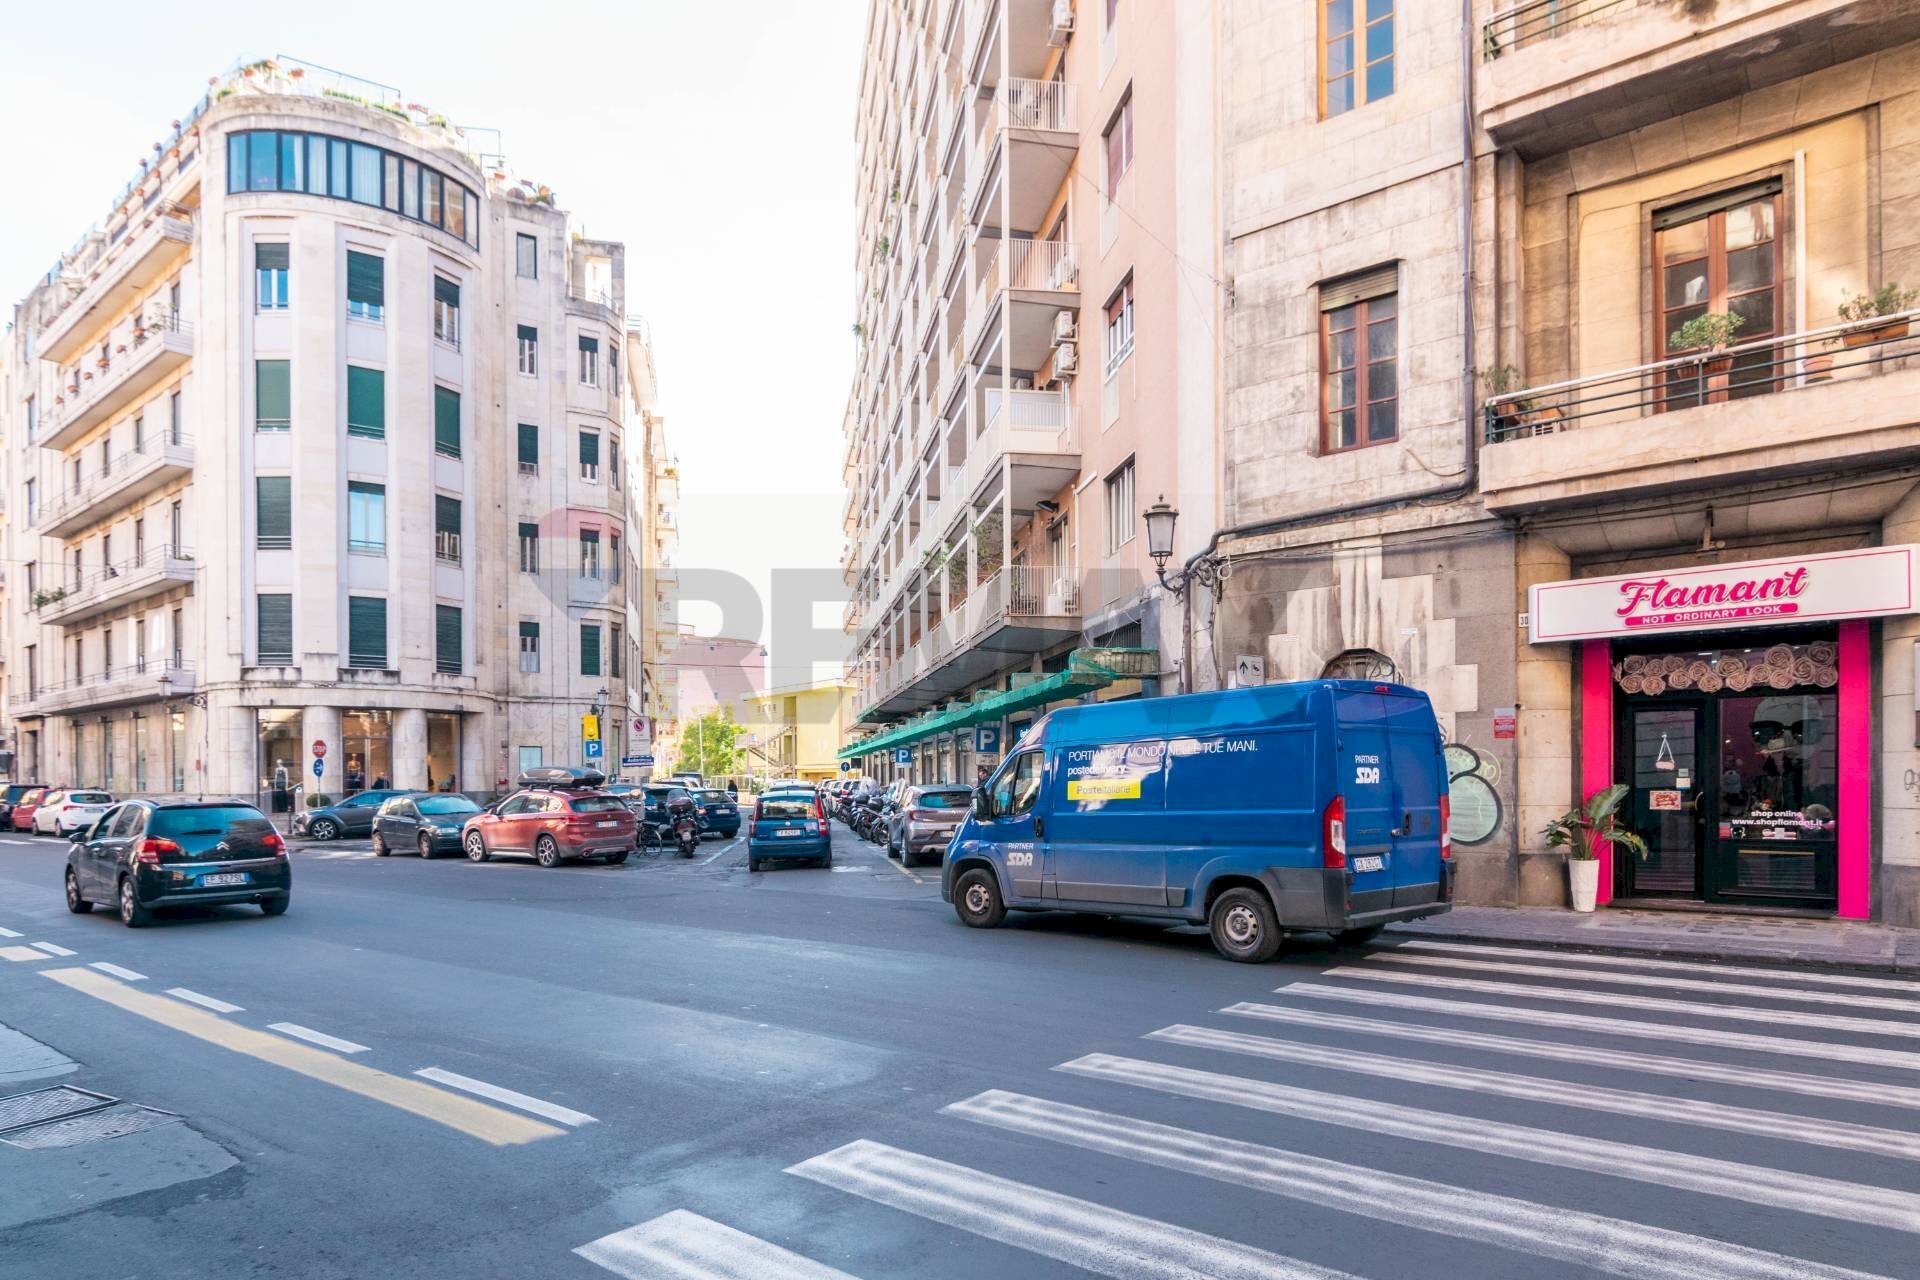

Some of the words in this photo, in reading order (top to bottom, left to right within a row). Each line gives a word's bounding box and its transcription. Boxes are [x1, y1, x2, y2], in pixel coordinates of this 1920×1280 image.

[1616, 566, 1808, 615] Flamant
[1642, 614, 1665, 625] NOT
[1673, 609, 1738, 622] ORDINARY
[1746, 603, 1783, 617] LOOK
[980, 729, 996, 750] P
[590, 743, 599, 755] P
[899, 749, 909, 762] P
[1128, 744, 1166, 758] MONDO
[1204, 741, 1224, 754] TUE
[1226, 740, 1258, 753] MANI.
[1354, 754, 1379, 764] PARTNER
[1355, 767, 1380, 784] SDA
[1750, 810, 1772, 819] shop
[1774, 809, 1802, 817] online
[1731, 817, 1823, 827] www.shopflamant.it
[1007, 842, 1034, 850] PARTNER
[1006, 852, 1034, 866] SDA
